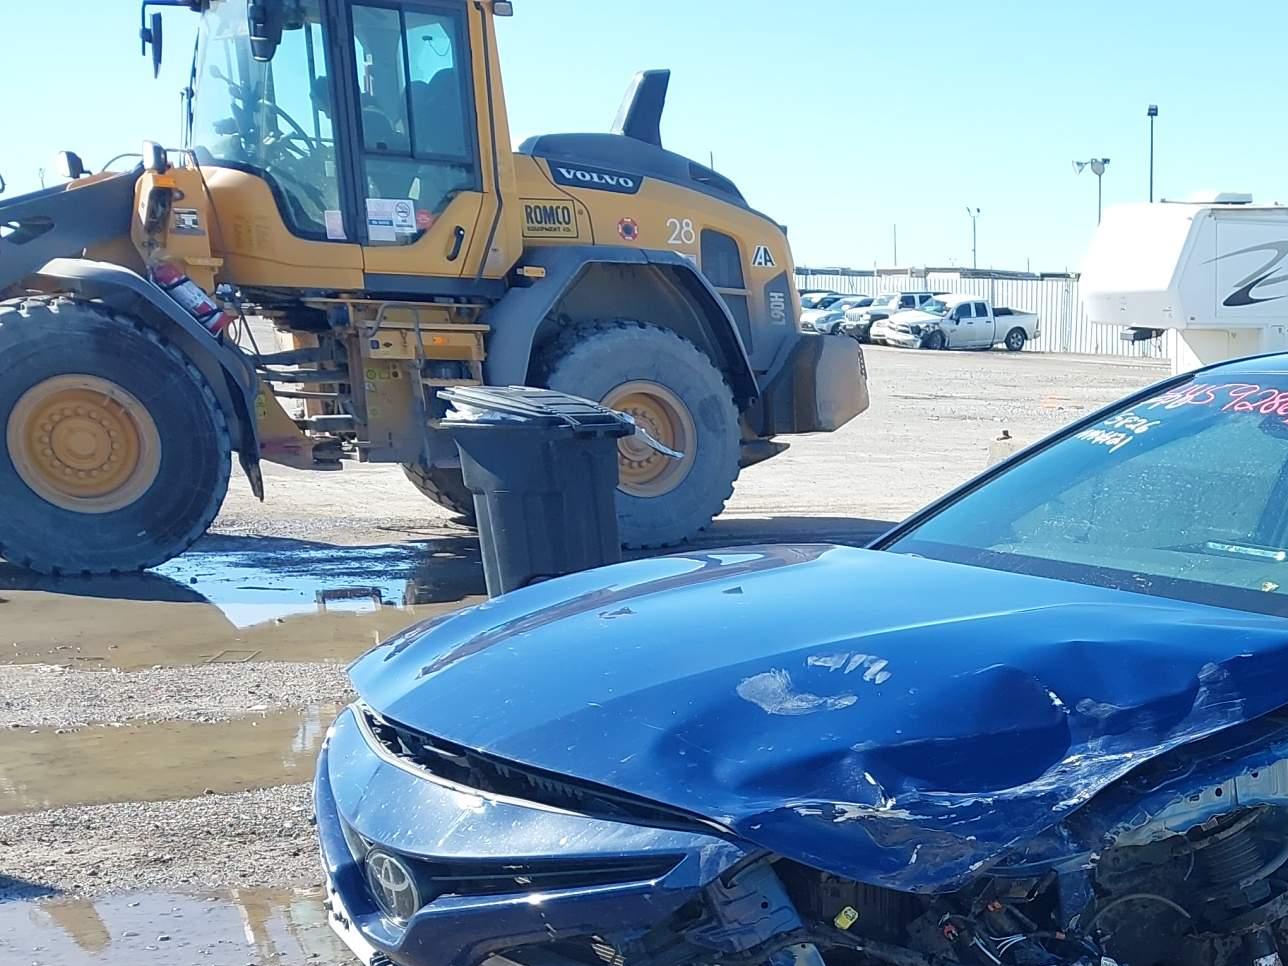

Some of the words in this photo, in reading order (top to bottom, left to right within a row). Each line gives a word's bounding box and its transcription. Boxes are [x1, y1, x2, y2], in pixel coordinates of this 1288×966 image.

[557, 167, 634, 188] VOLVO
[524, 204, 571, 225] ROMCO
[666, 218, 696, 244] 28
[769, 292, 785, 325] L90H
